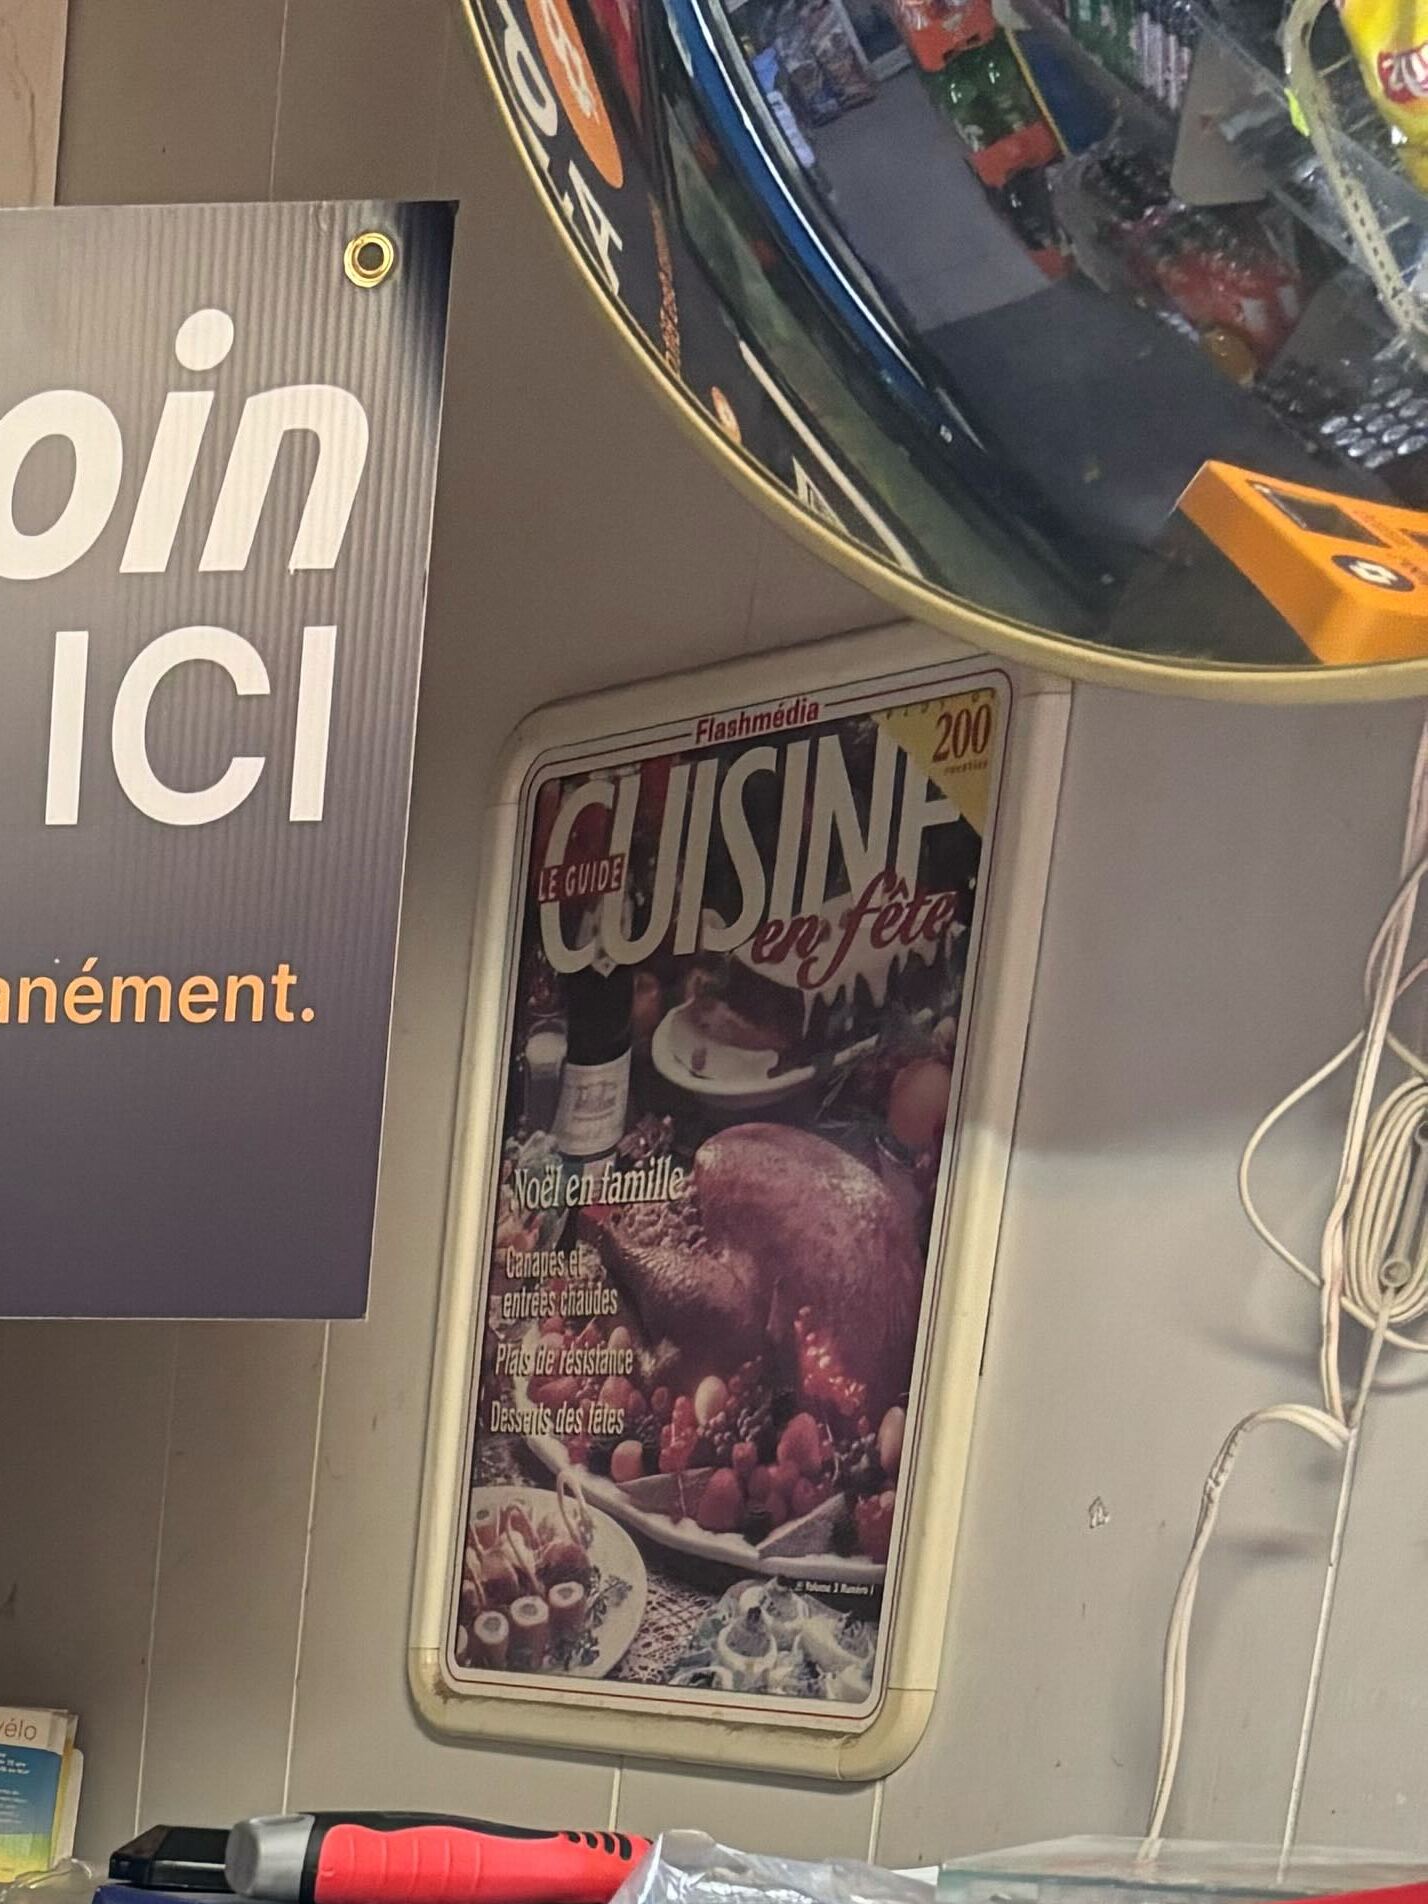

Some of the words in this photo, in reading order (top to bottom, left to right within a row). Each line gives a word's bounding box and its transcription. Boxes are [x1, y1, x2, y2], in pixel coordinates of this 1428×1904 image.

[44, 624, 338, 827] ICI
[696, 697, 820, 746] Flashmédia
[932, 703, 992, 763] 200
[564, 855, 624, 896] GUIDE
[752, 914, 828, 965] en
[796, 866, 958, 992] fête
[510, 1162, 562, 1209] Noël
[565, 1174, 596, 1209] en
[600, 1154, 684, 1205] famille
[559, 1283, 619, 1316] chaudes
[555, 1401, 583, 1434] des
